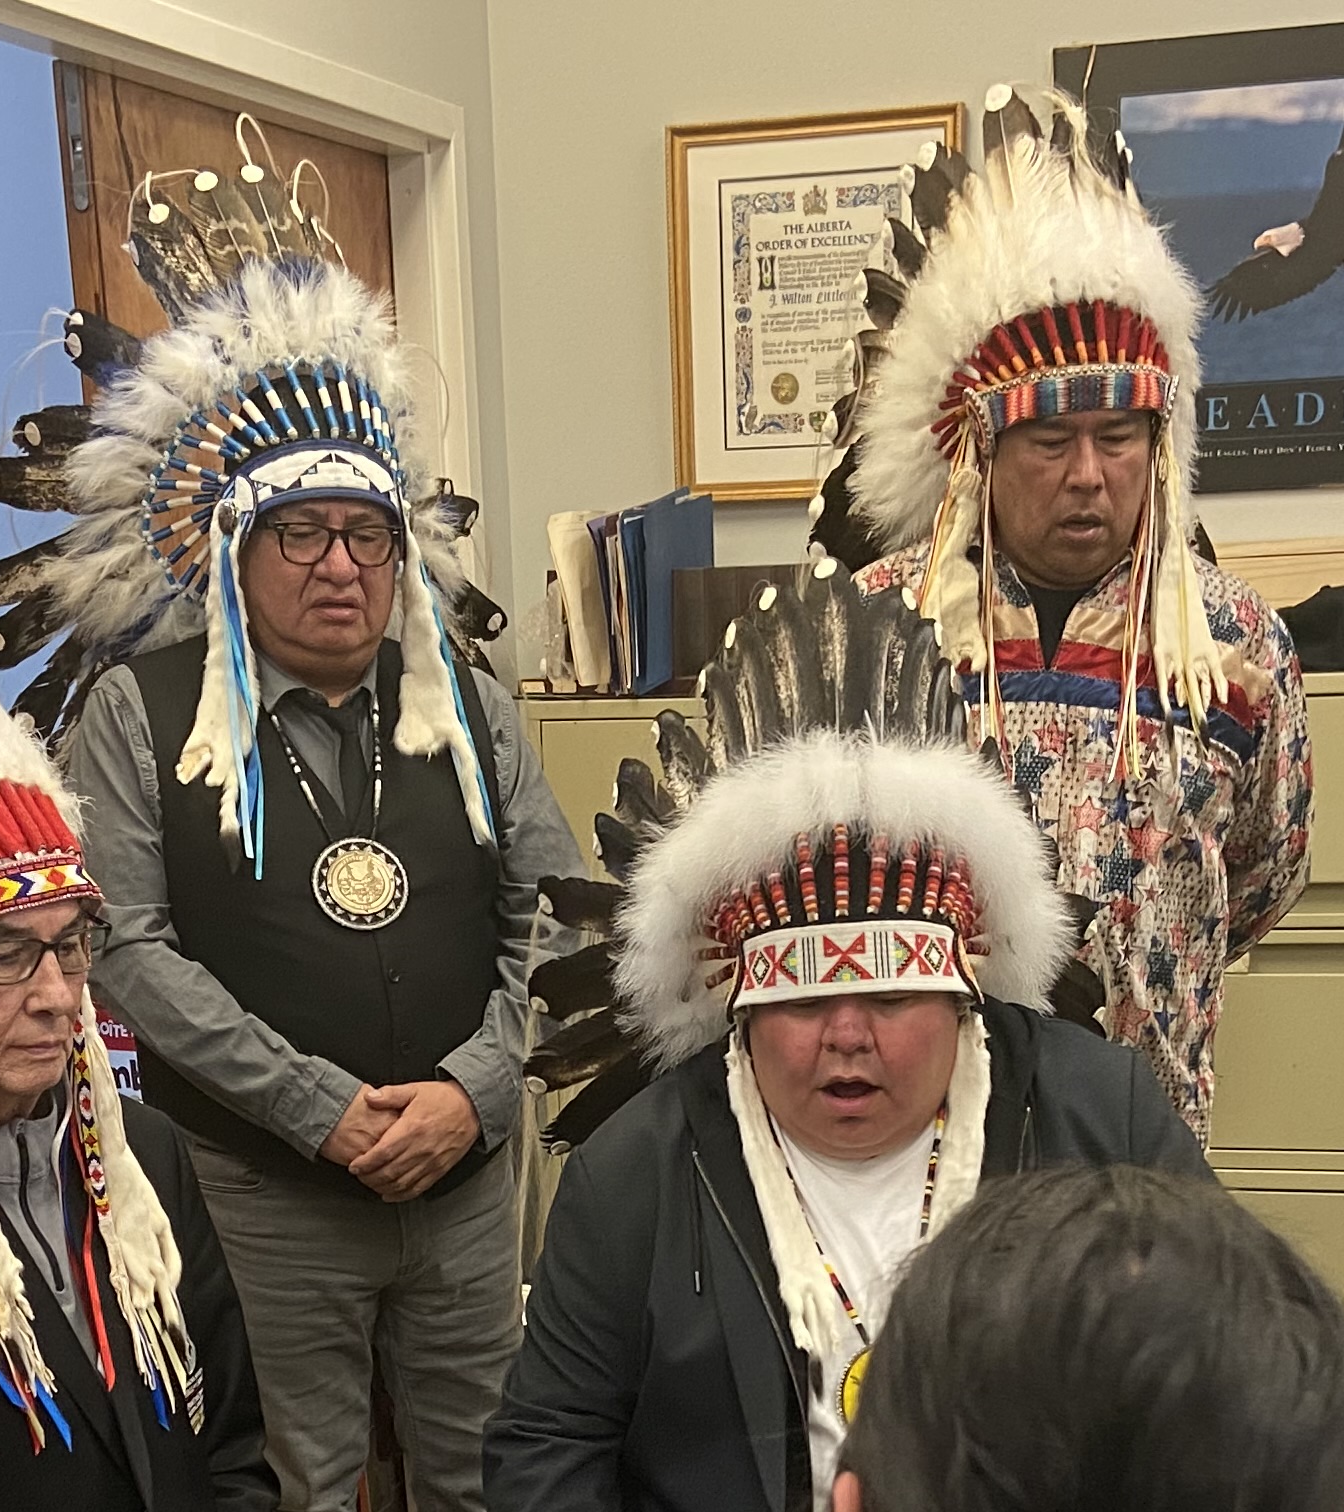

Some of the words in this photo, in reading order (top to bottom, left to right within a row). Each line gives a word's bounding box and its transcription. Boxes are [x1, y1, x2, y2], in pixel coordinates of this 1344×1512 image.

[783, 224, 805, 236] THE
[806, 220, 852, 234] ALBERTA
[756, 239, 793, 252] ORDER
[794, 238, 809, 250] OF
[811, 232, 877, 249] EXCELLENCE
